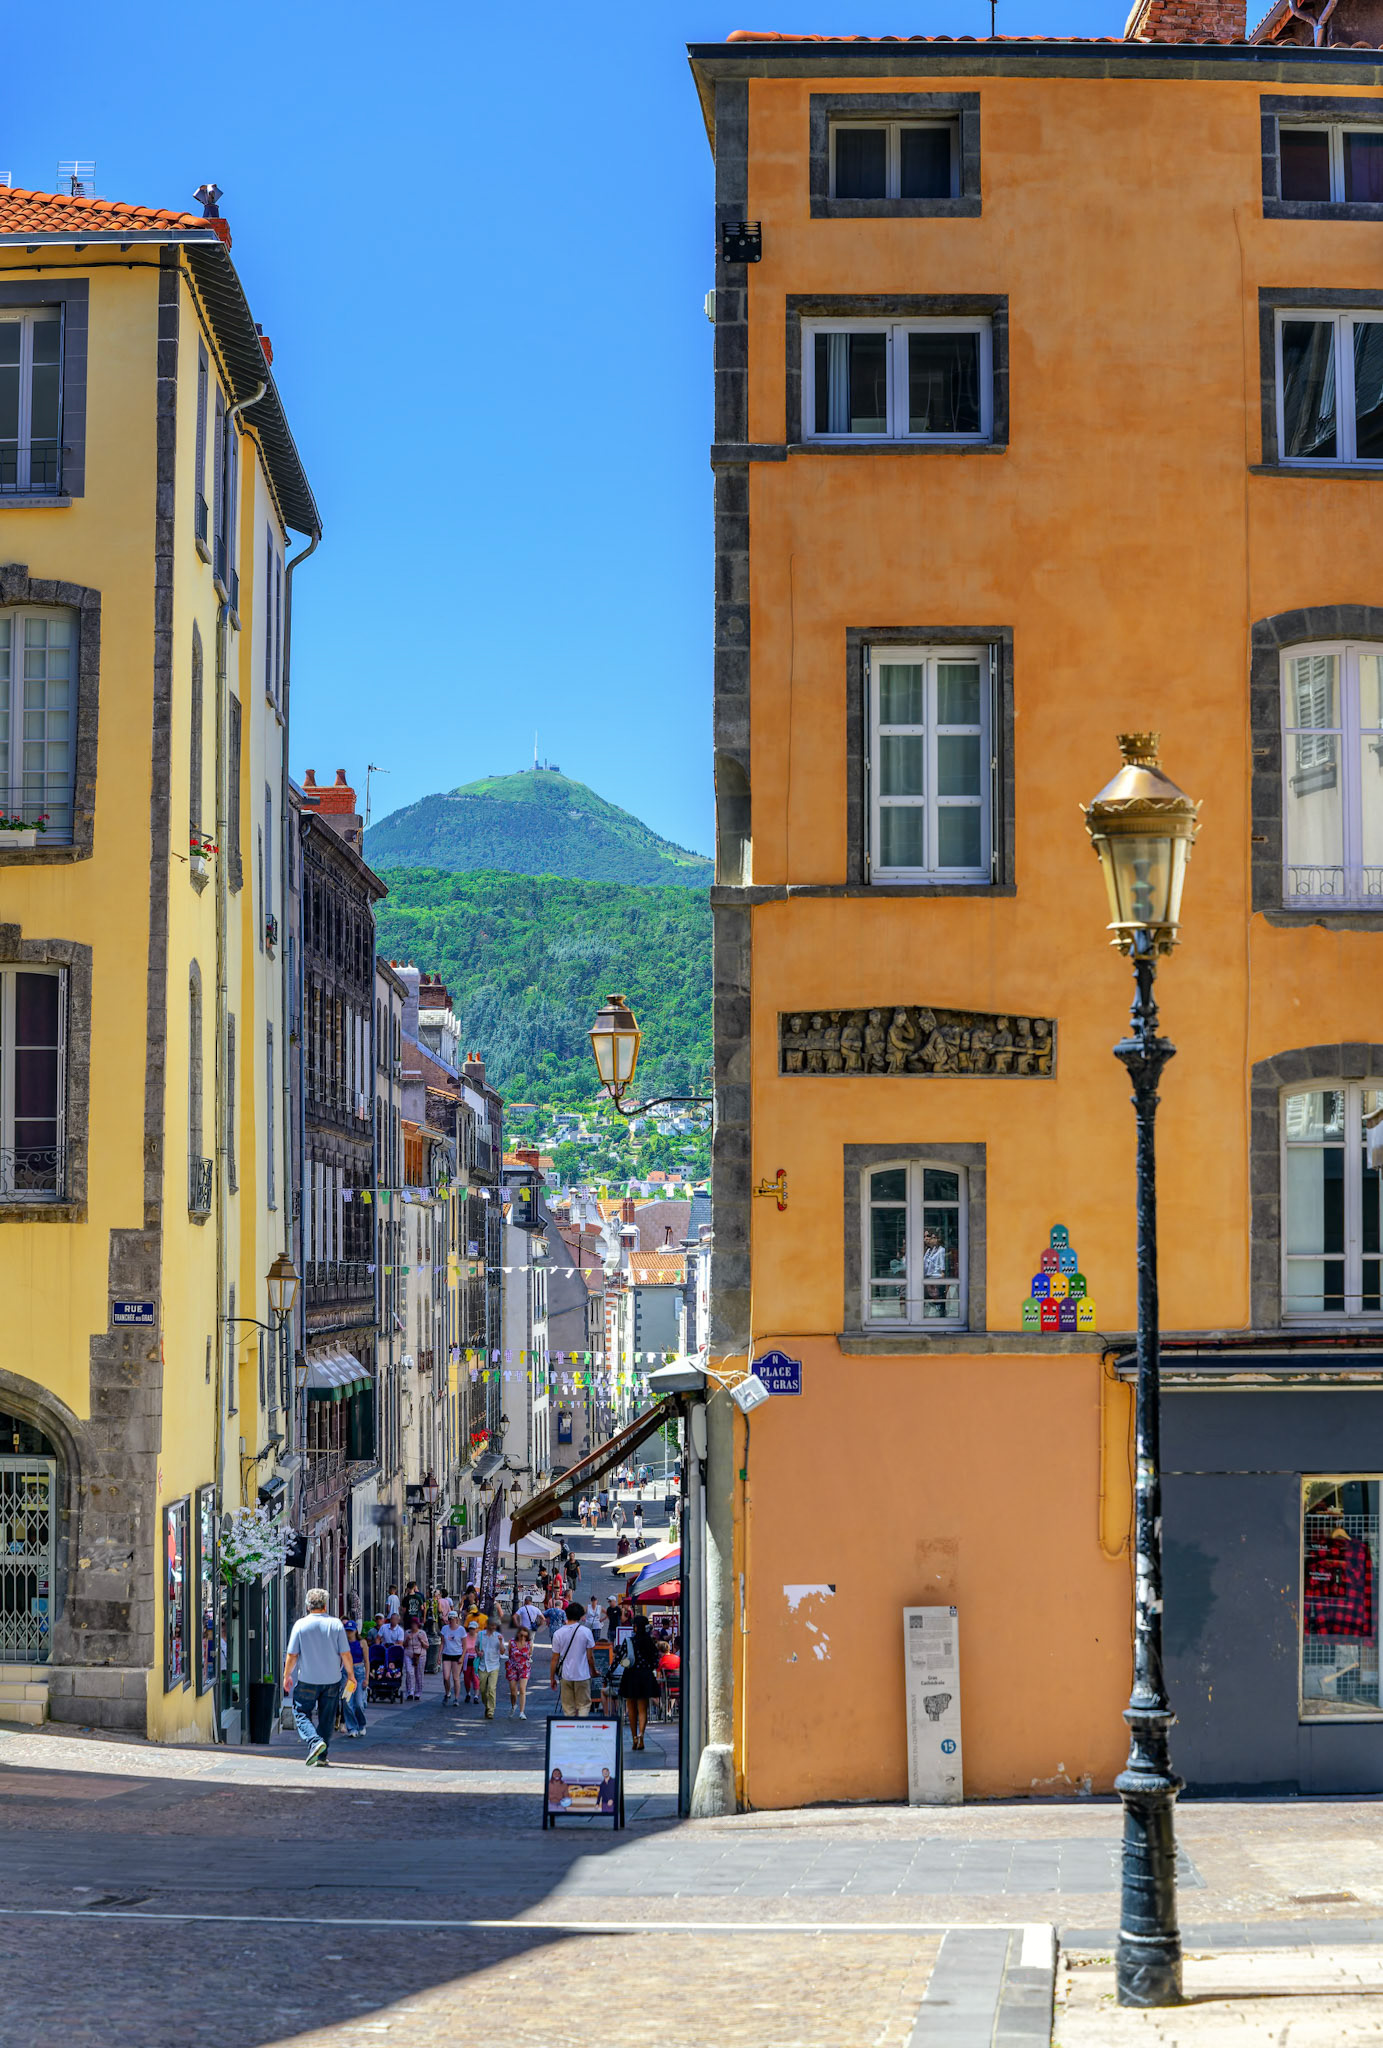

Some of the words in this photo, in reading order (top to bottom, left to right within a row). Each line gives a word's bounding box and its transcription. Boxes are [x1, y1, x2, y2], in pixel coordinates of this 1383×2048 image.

[114, 1313, 135, 1322] TRANCHÉE
[141, 1314, 153, 1322] GRAS
[772, 1355, 779, 1365] N
[759, 1366, 791, 1377] PLACE
[773, 1379, 799, 1390] GRAS
[942, 1742, 955, 1752] 15
